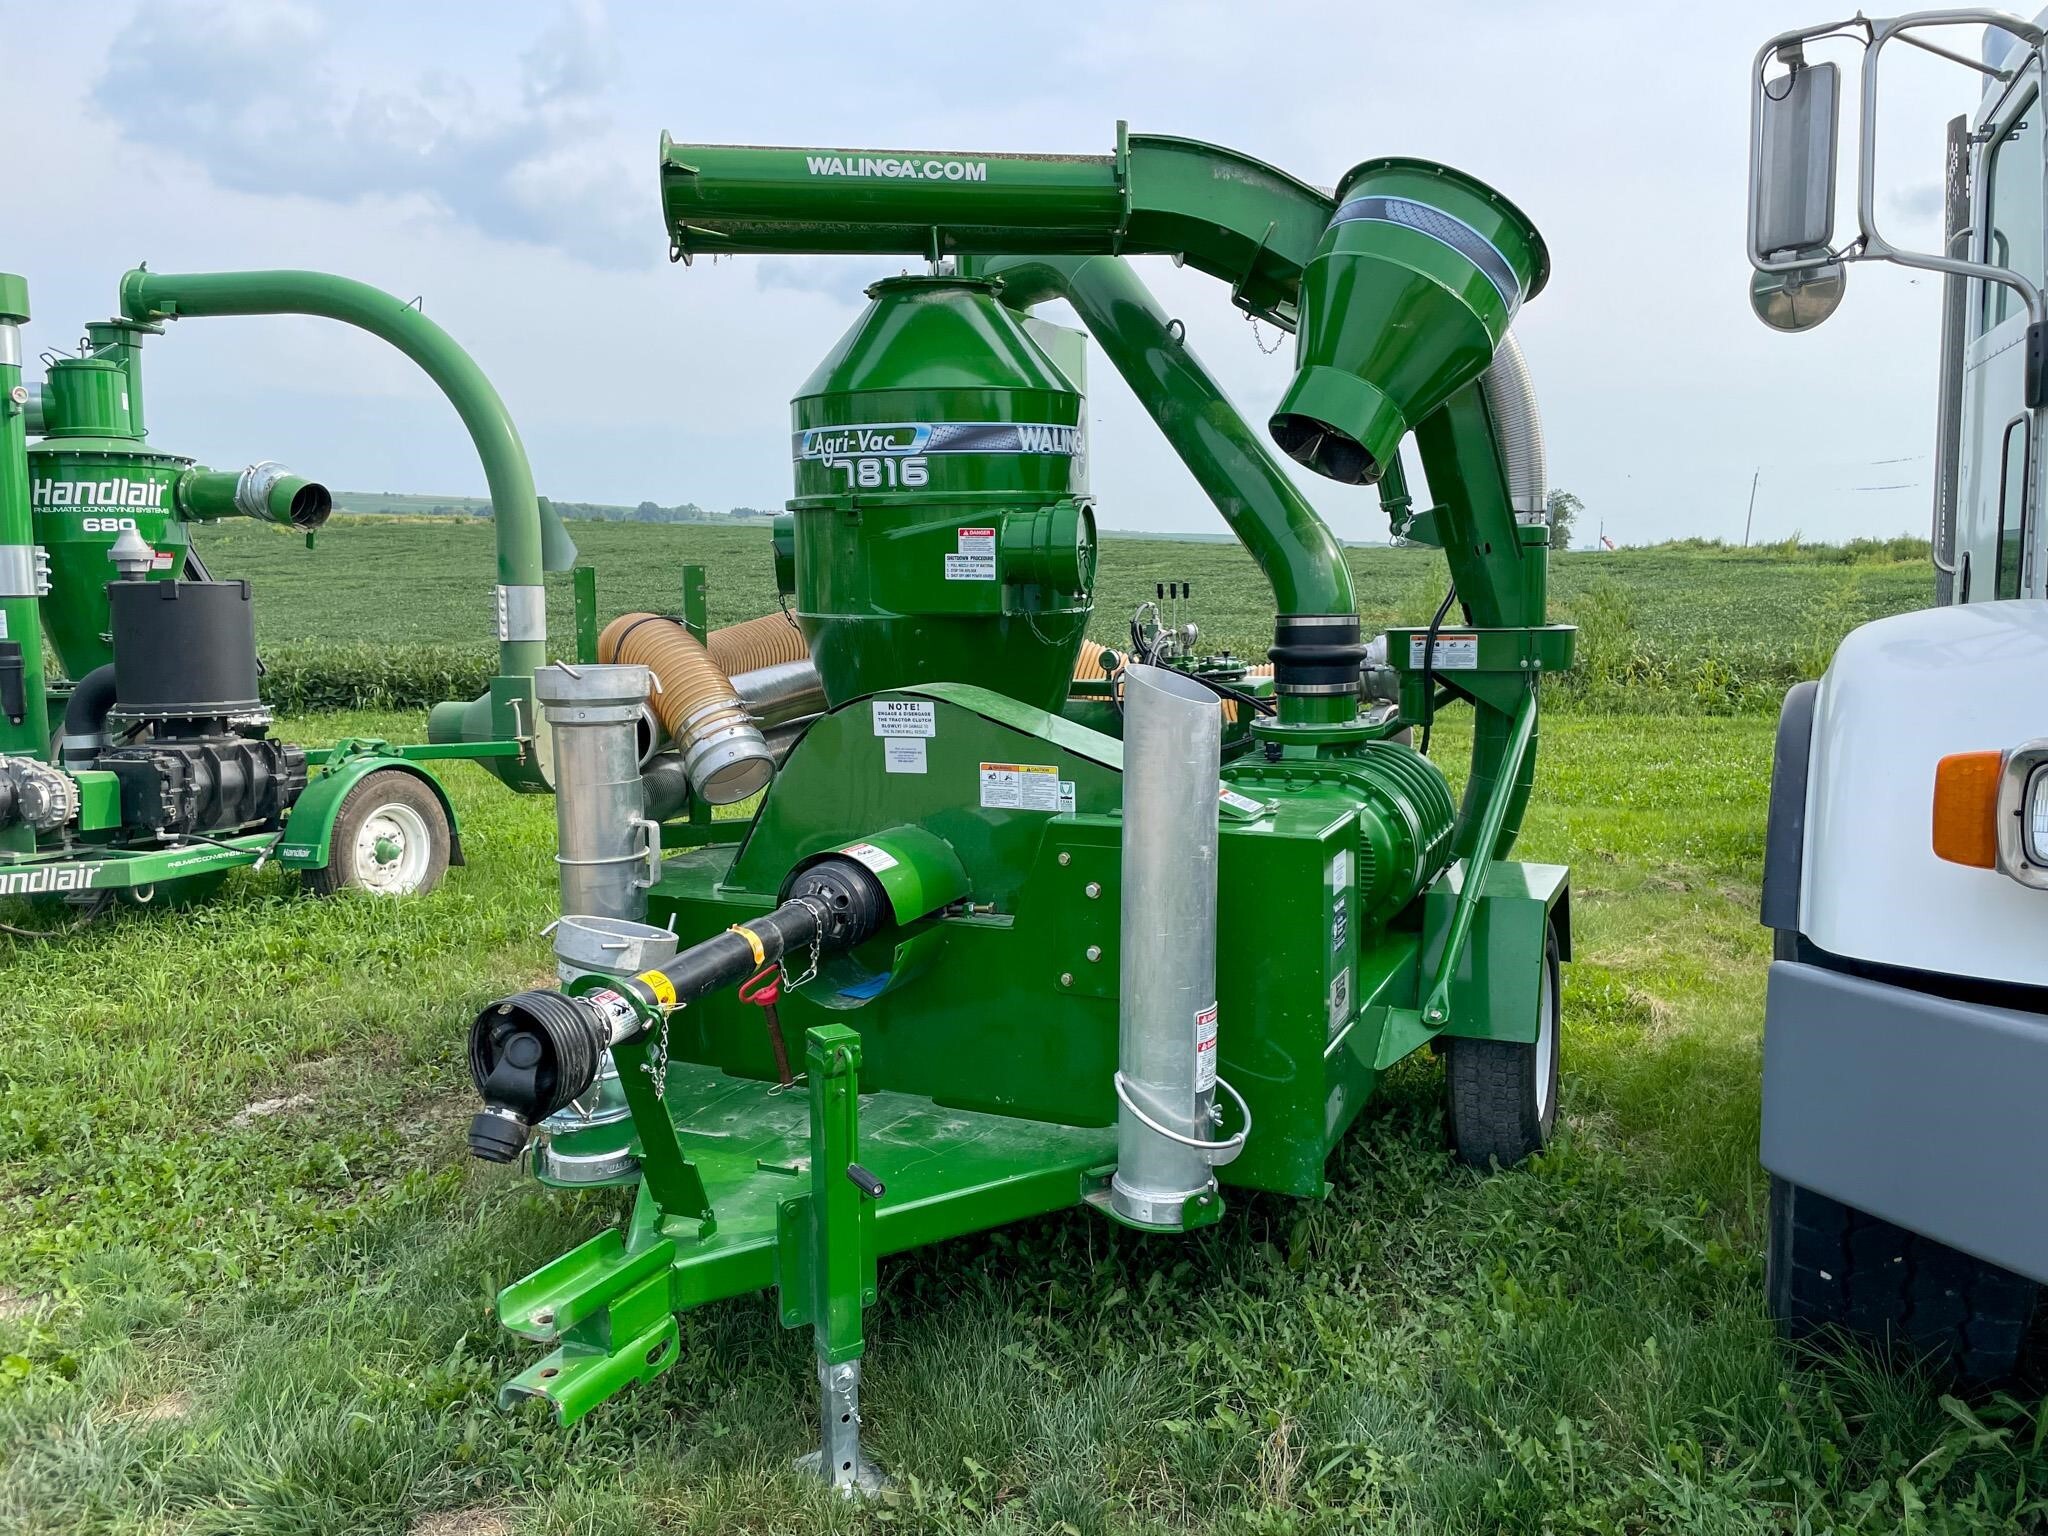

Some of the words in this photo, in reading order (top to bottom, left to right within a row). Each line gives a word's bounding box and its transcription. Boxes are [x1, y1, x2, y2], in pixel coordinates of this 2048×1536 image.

[814, 430, 895, 467] Agri-Vac
[832, 457, 930, 488] 7816
[33, 478, 168, 506] Handlair
[83, 518, 136, 531] 680
[888, 703, 920, 711] NOTE!
